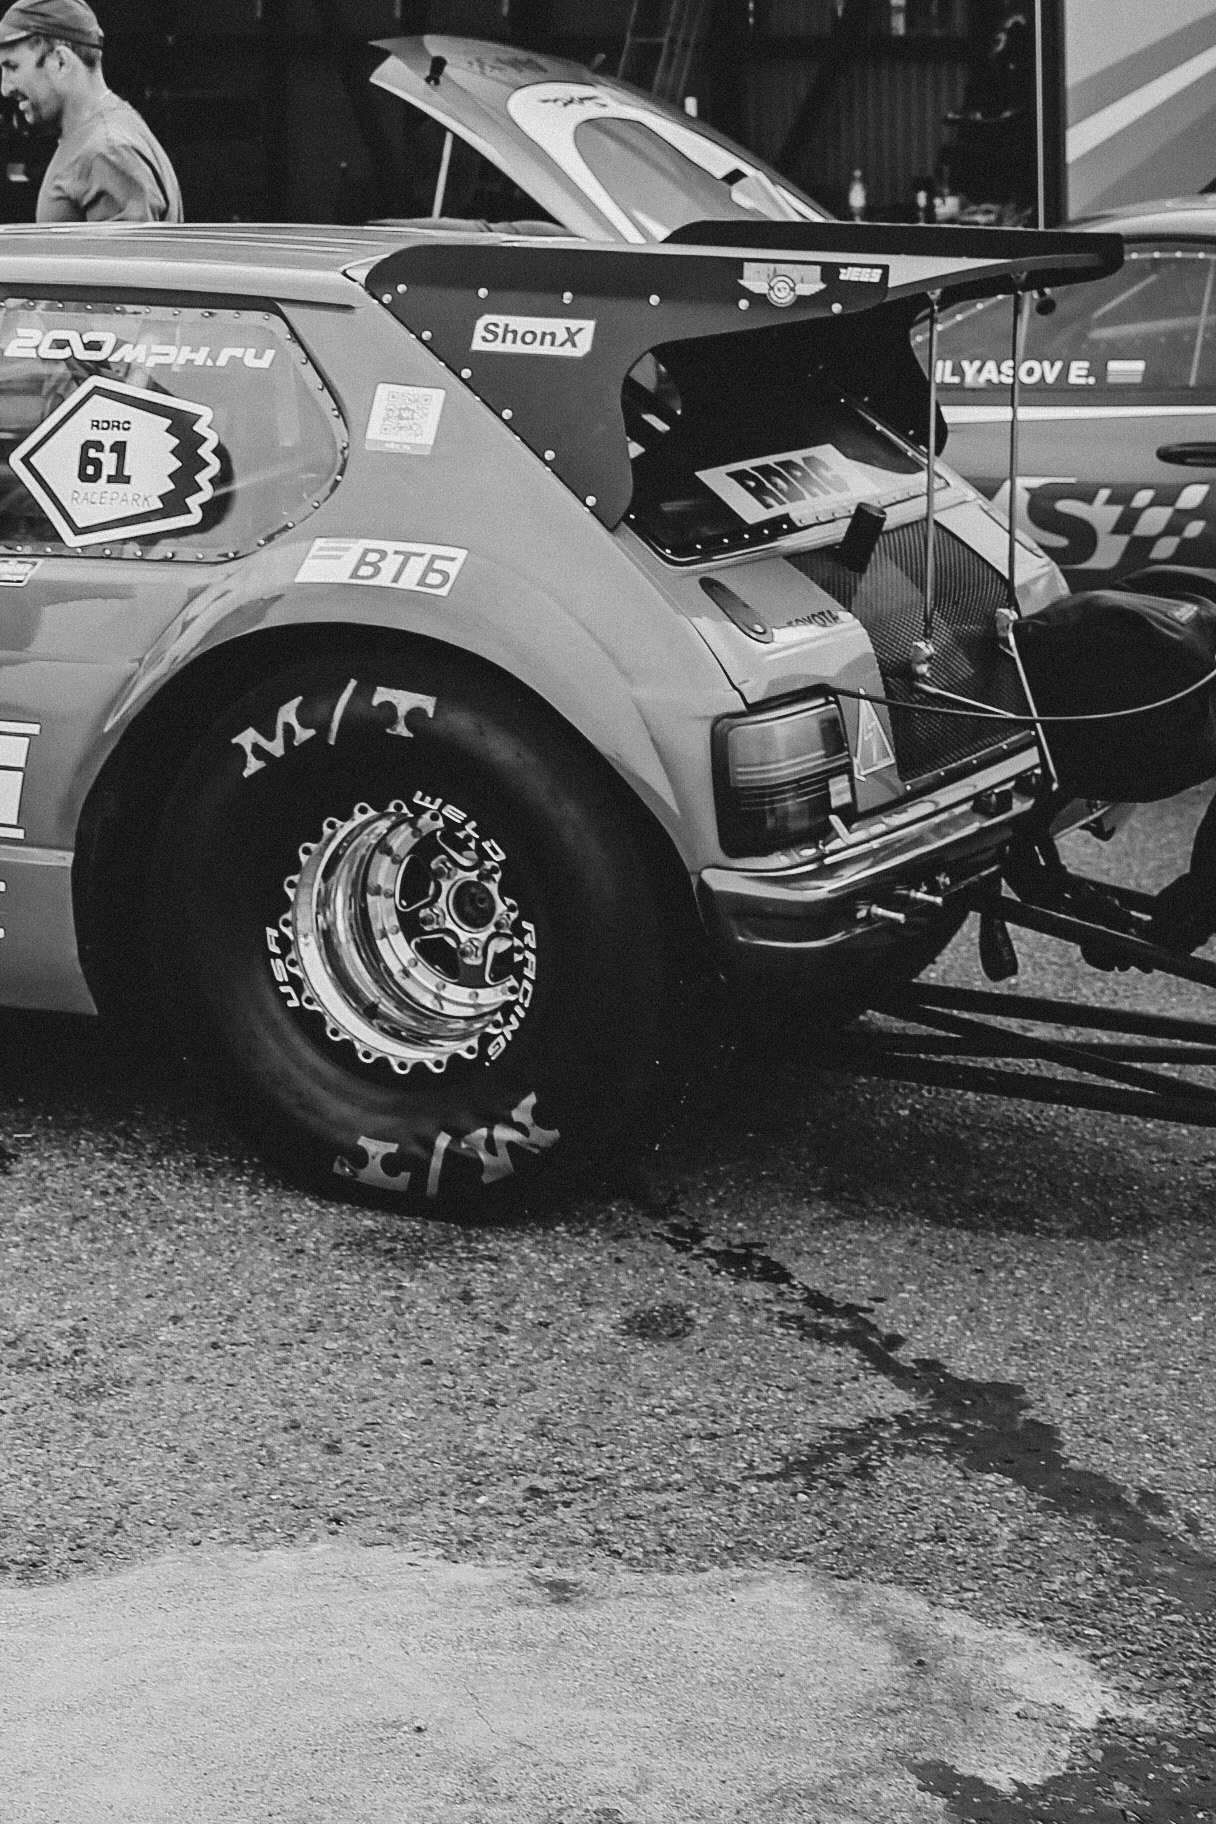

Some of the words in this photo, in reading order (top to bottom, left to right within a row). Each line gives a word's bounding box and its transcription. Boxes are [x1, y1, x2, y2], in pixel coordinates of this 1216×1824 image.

[481, 322, 584, 348] ShonX
[935, 359, 1064, 385] ILYASOV
[1067, 360, 1096, 385] E.
[90, 419, 131, 431] RDRC
[77, 440, 131, 485] 61
[71, 490, 151, 507] RACEPARK
[348, 548, 459, 589] ВТБ
[231, 678, 437, 778] M/T
[413, 790, 506, 862] WELD
[266, 927, 300, 1008] USA
